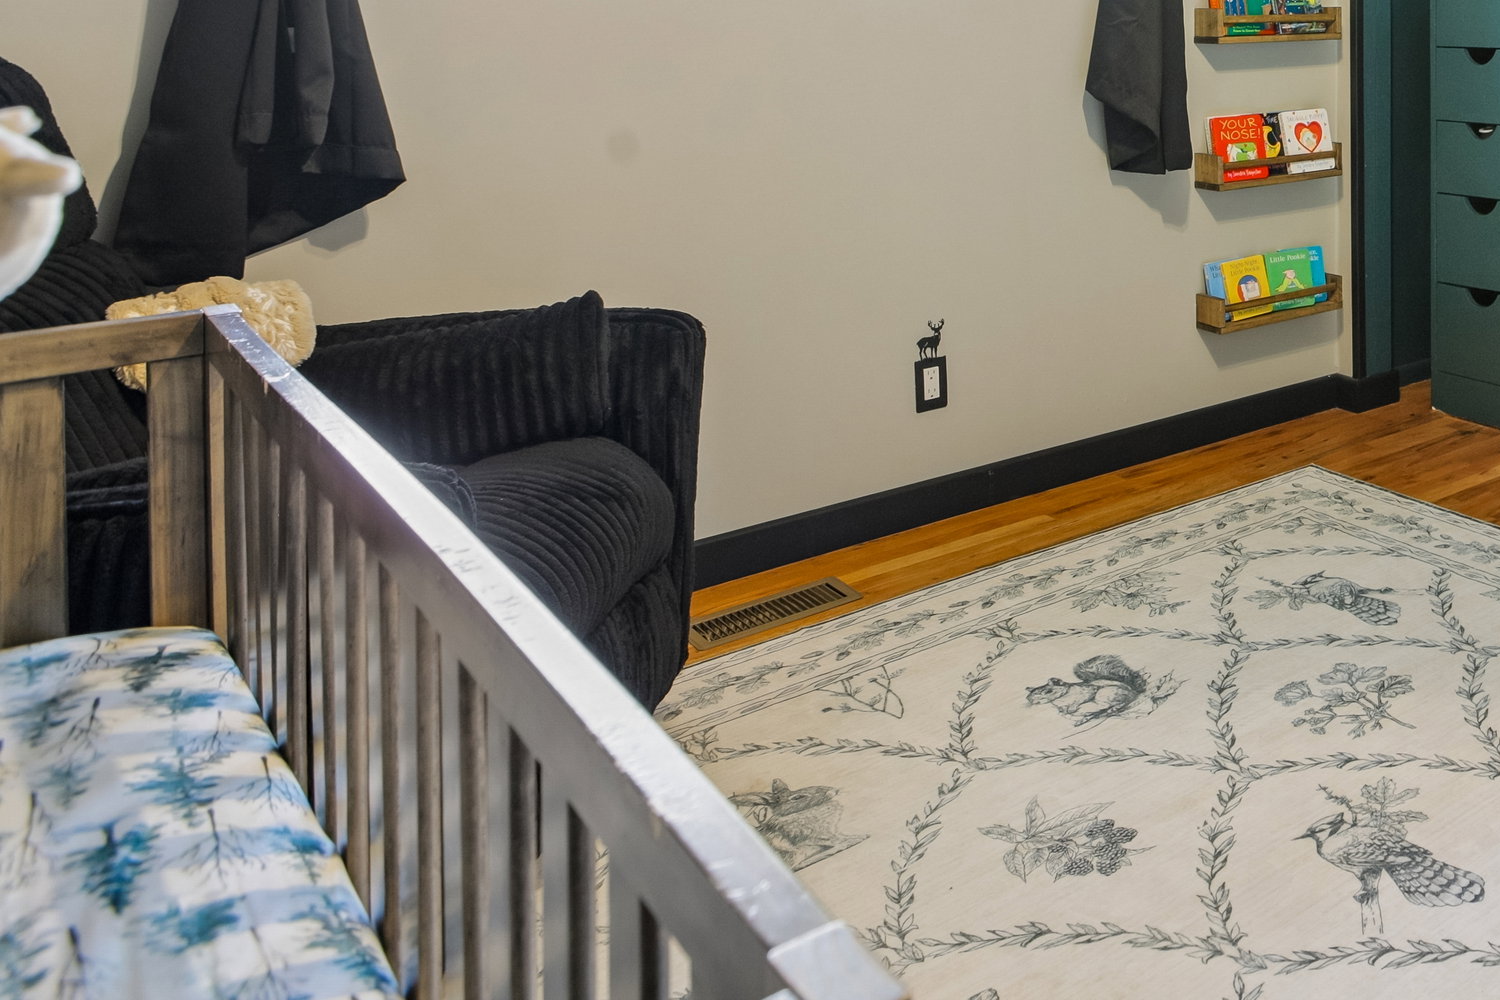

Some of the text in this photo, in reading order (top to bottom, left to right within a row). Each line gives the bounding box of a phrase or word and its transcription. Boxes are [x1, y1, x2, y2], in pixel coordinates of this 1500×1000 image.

[1220, 118, 1258, 129] YOUR
[1220, 128, 1261, 140] NOSE!
[1270, 255, 1286, 263] Little
